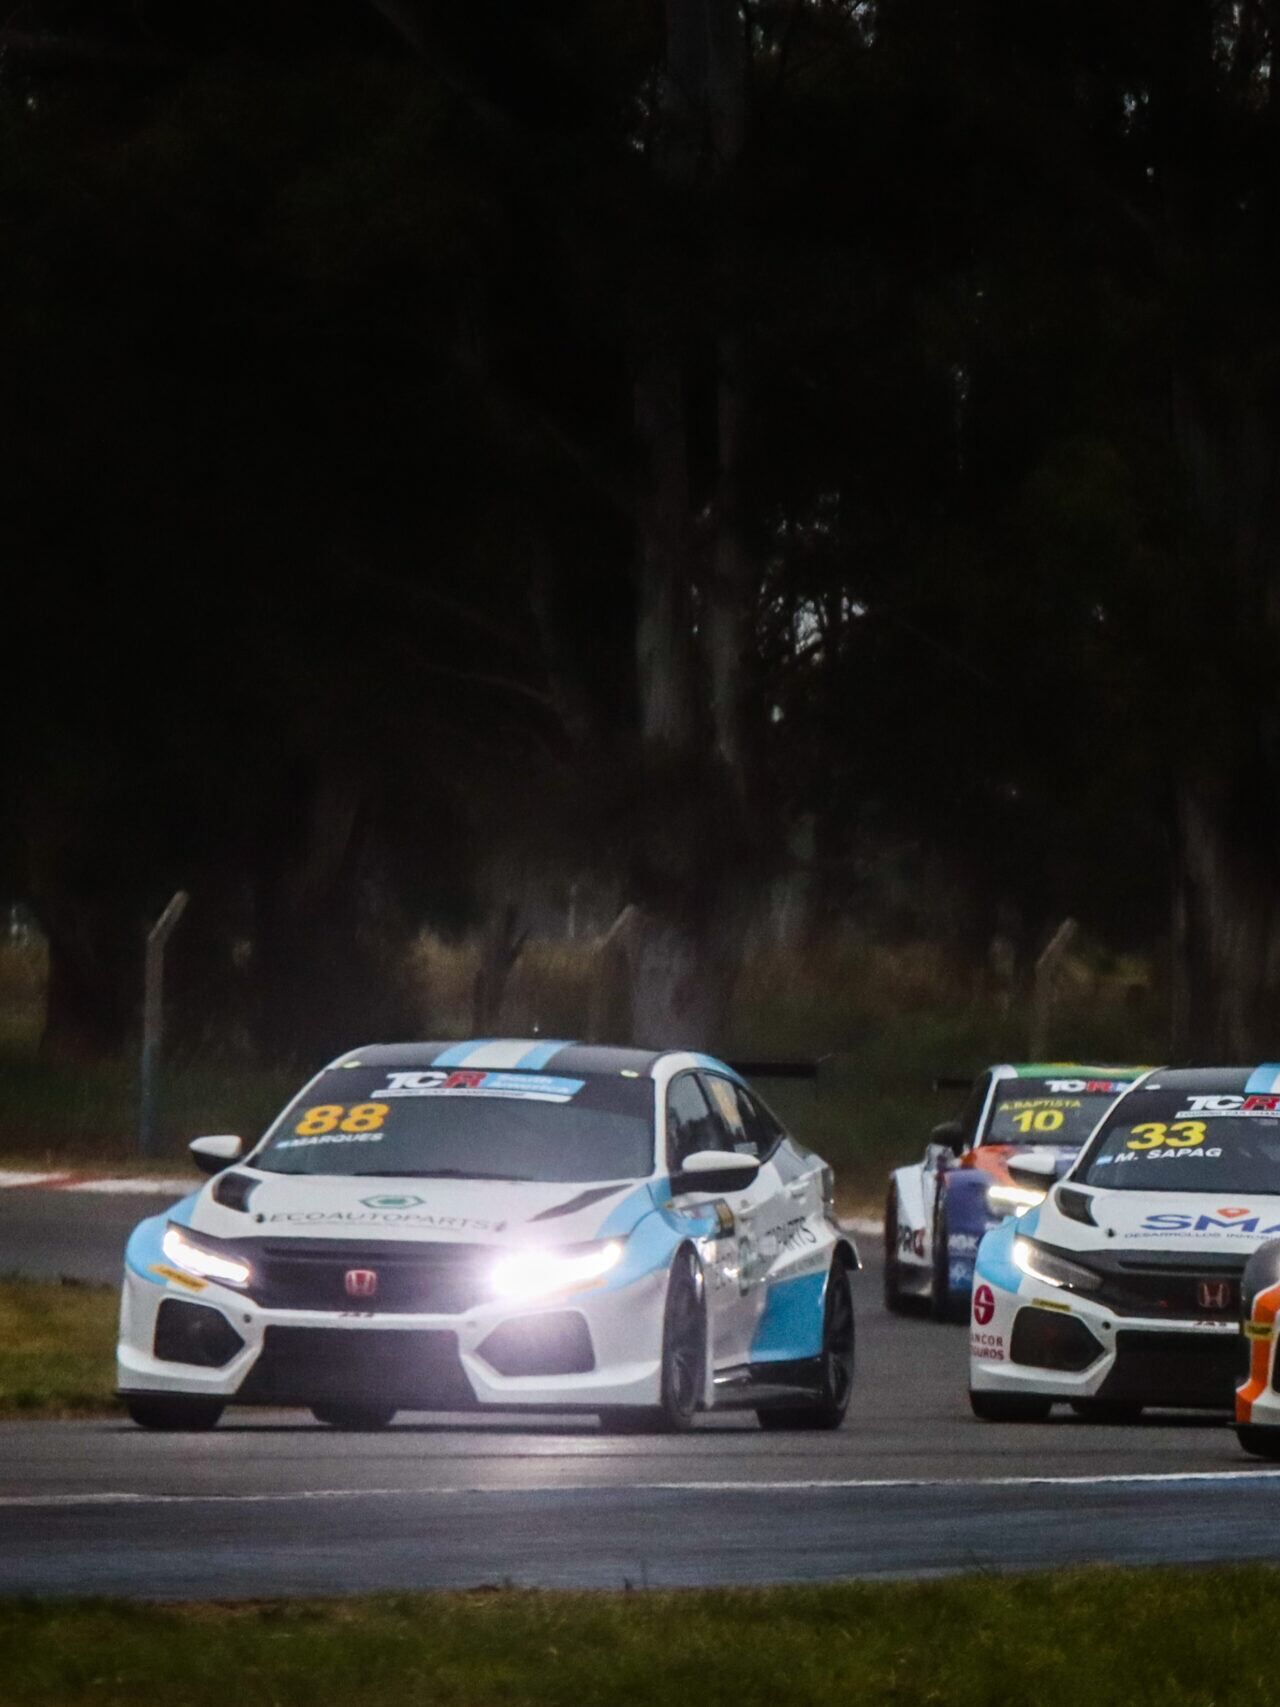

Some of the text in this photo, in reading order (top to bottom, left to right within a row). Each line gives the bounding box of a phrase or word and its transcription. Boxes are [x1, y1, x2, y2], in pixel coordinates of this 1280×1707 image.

[386, 1071, 487, 1089] TCR
[1045, 1079, 1112, 1093] TCR
[295, 1103, 390, 1136] 88
[1012, 1109, 1065, 1133] 10
[1126, 1121, 1207, 1150] 33
[1147, 1147, 1223, 1159] SAPAG
